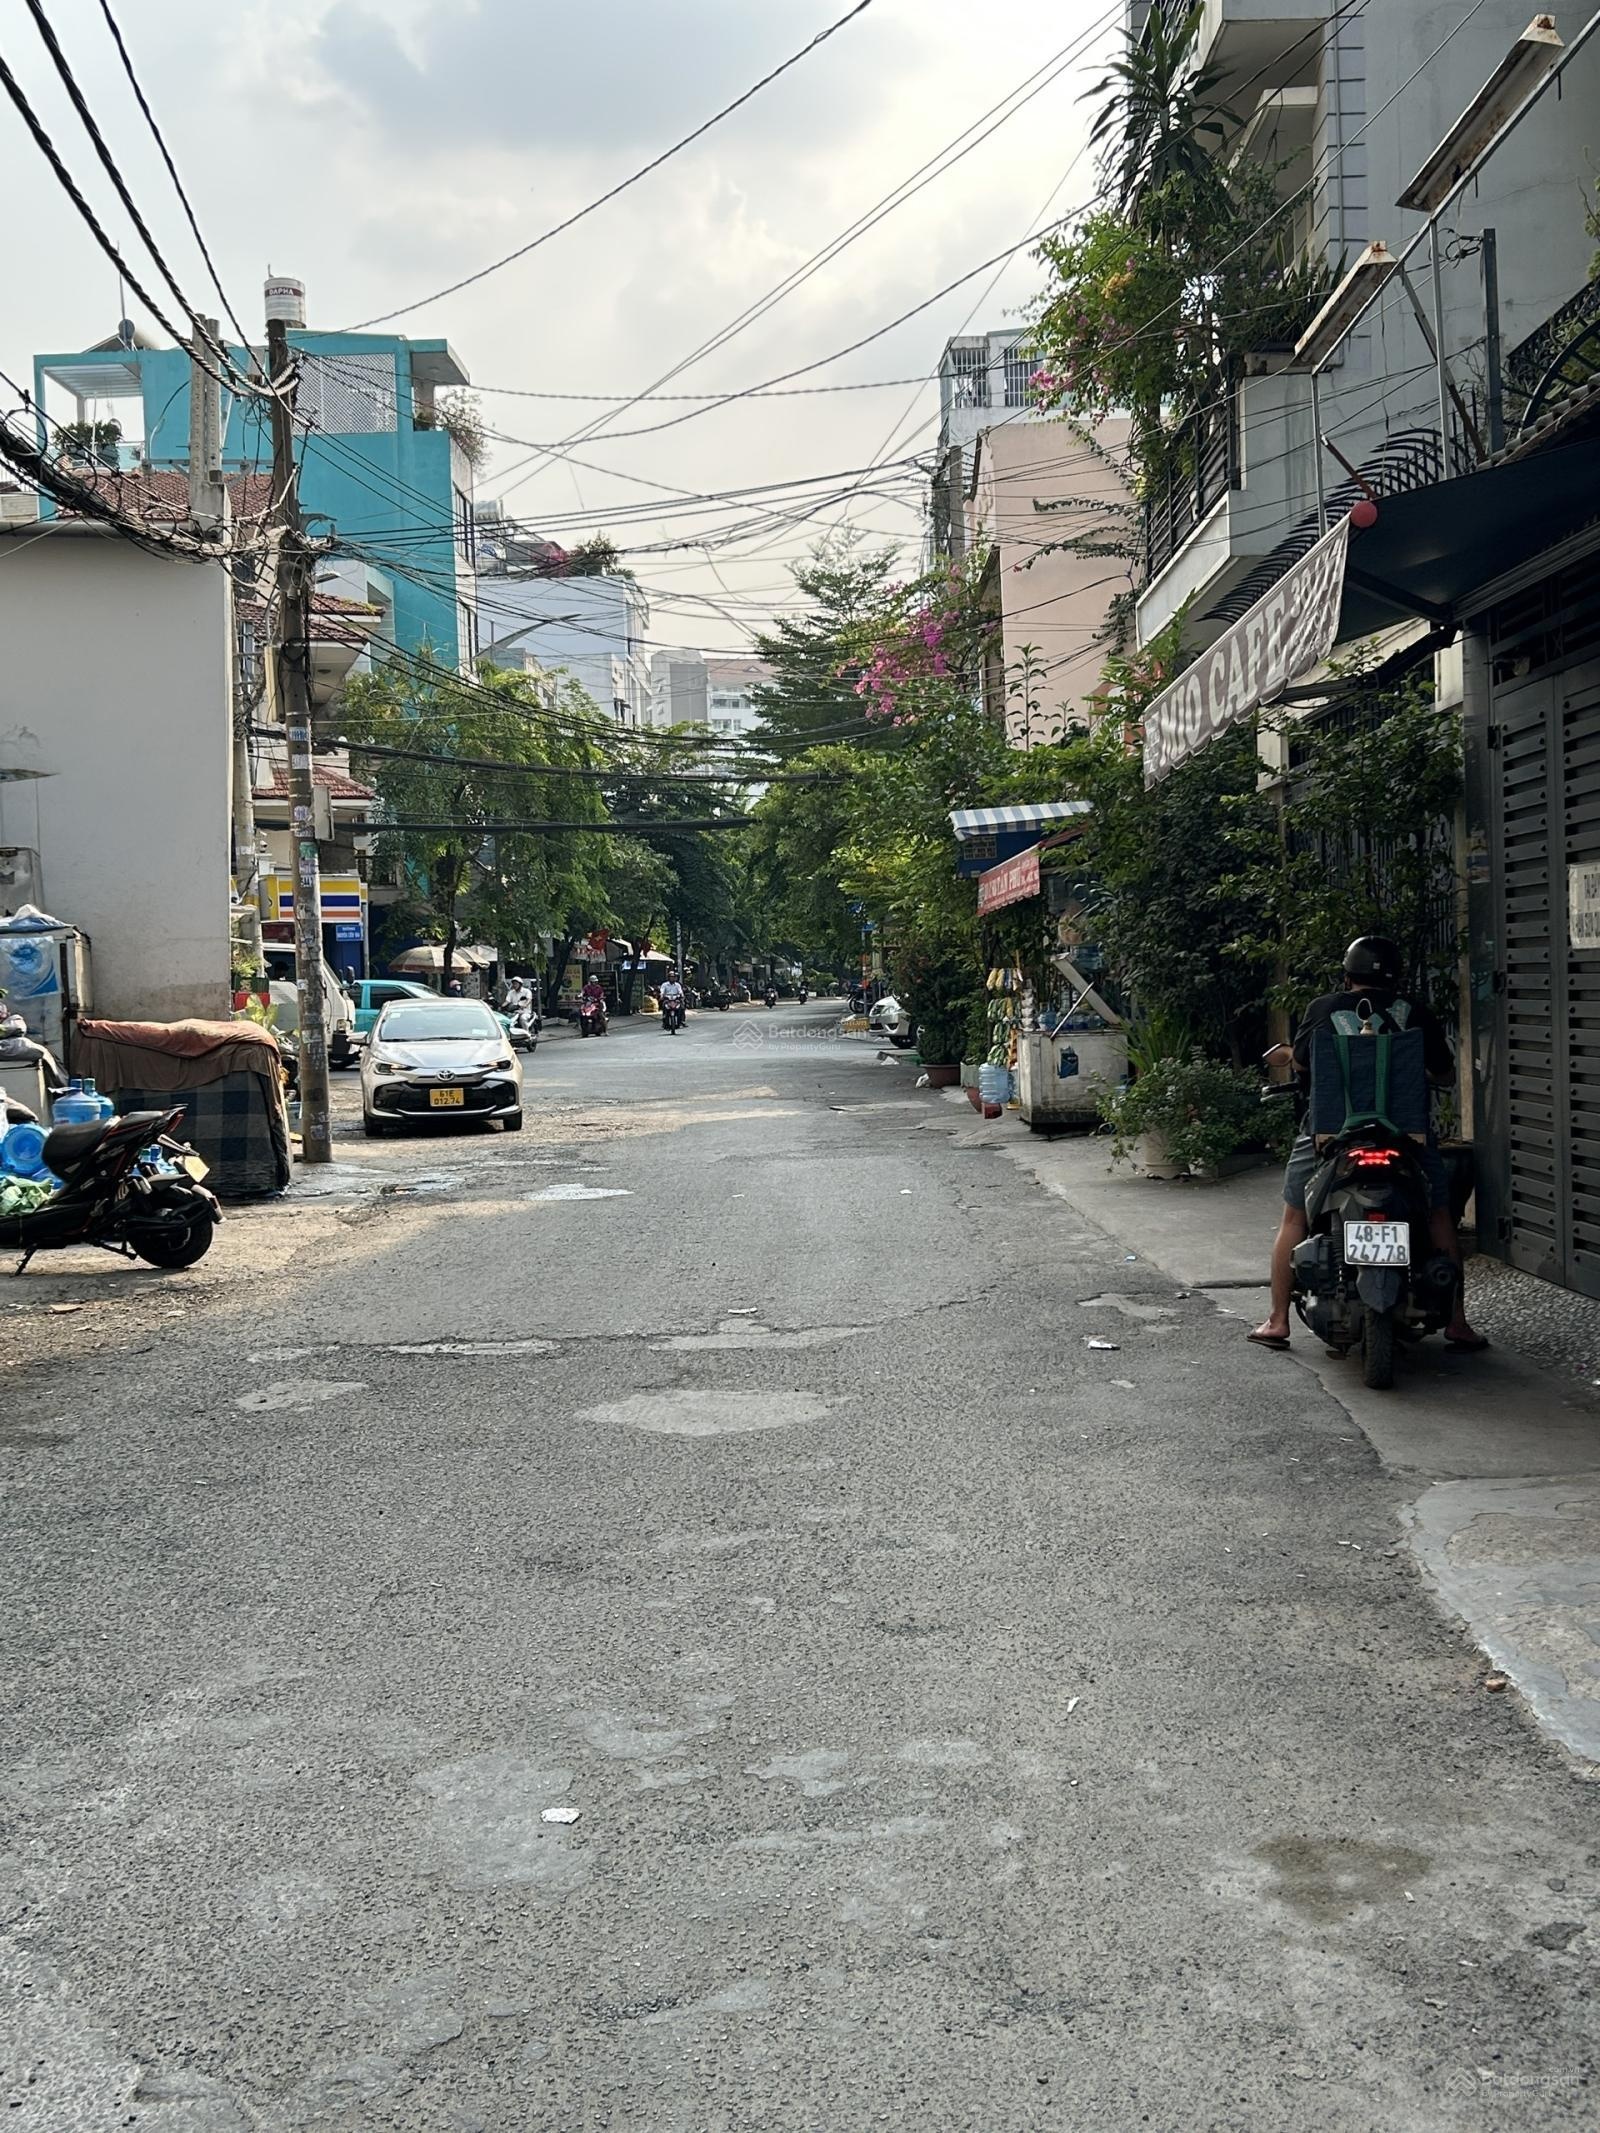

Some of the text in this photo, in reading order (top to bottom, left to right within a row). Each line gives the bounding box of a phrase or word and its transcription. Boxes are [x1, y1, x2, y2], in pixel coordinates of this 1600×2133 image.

[1209, 590, 1287, 727] CAFE
[1355, 1225, 1398, 1243] 48-F1
[1349, 1244, 1406, 1262] 247.78
